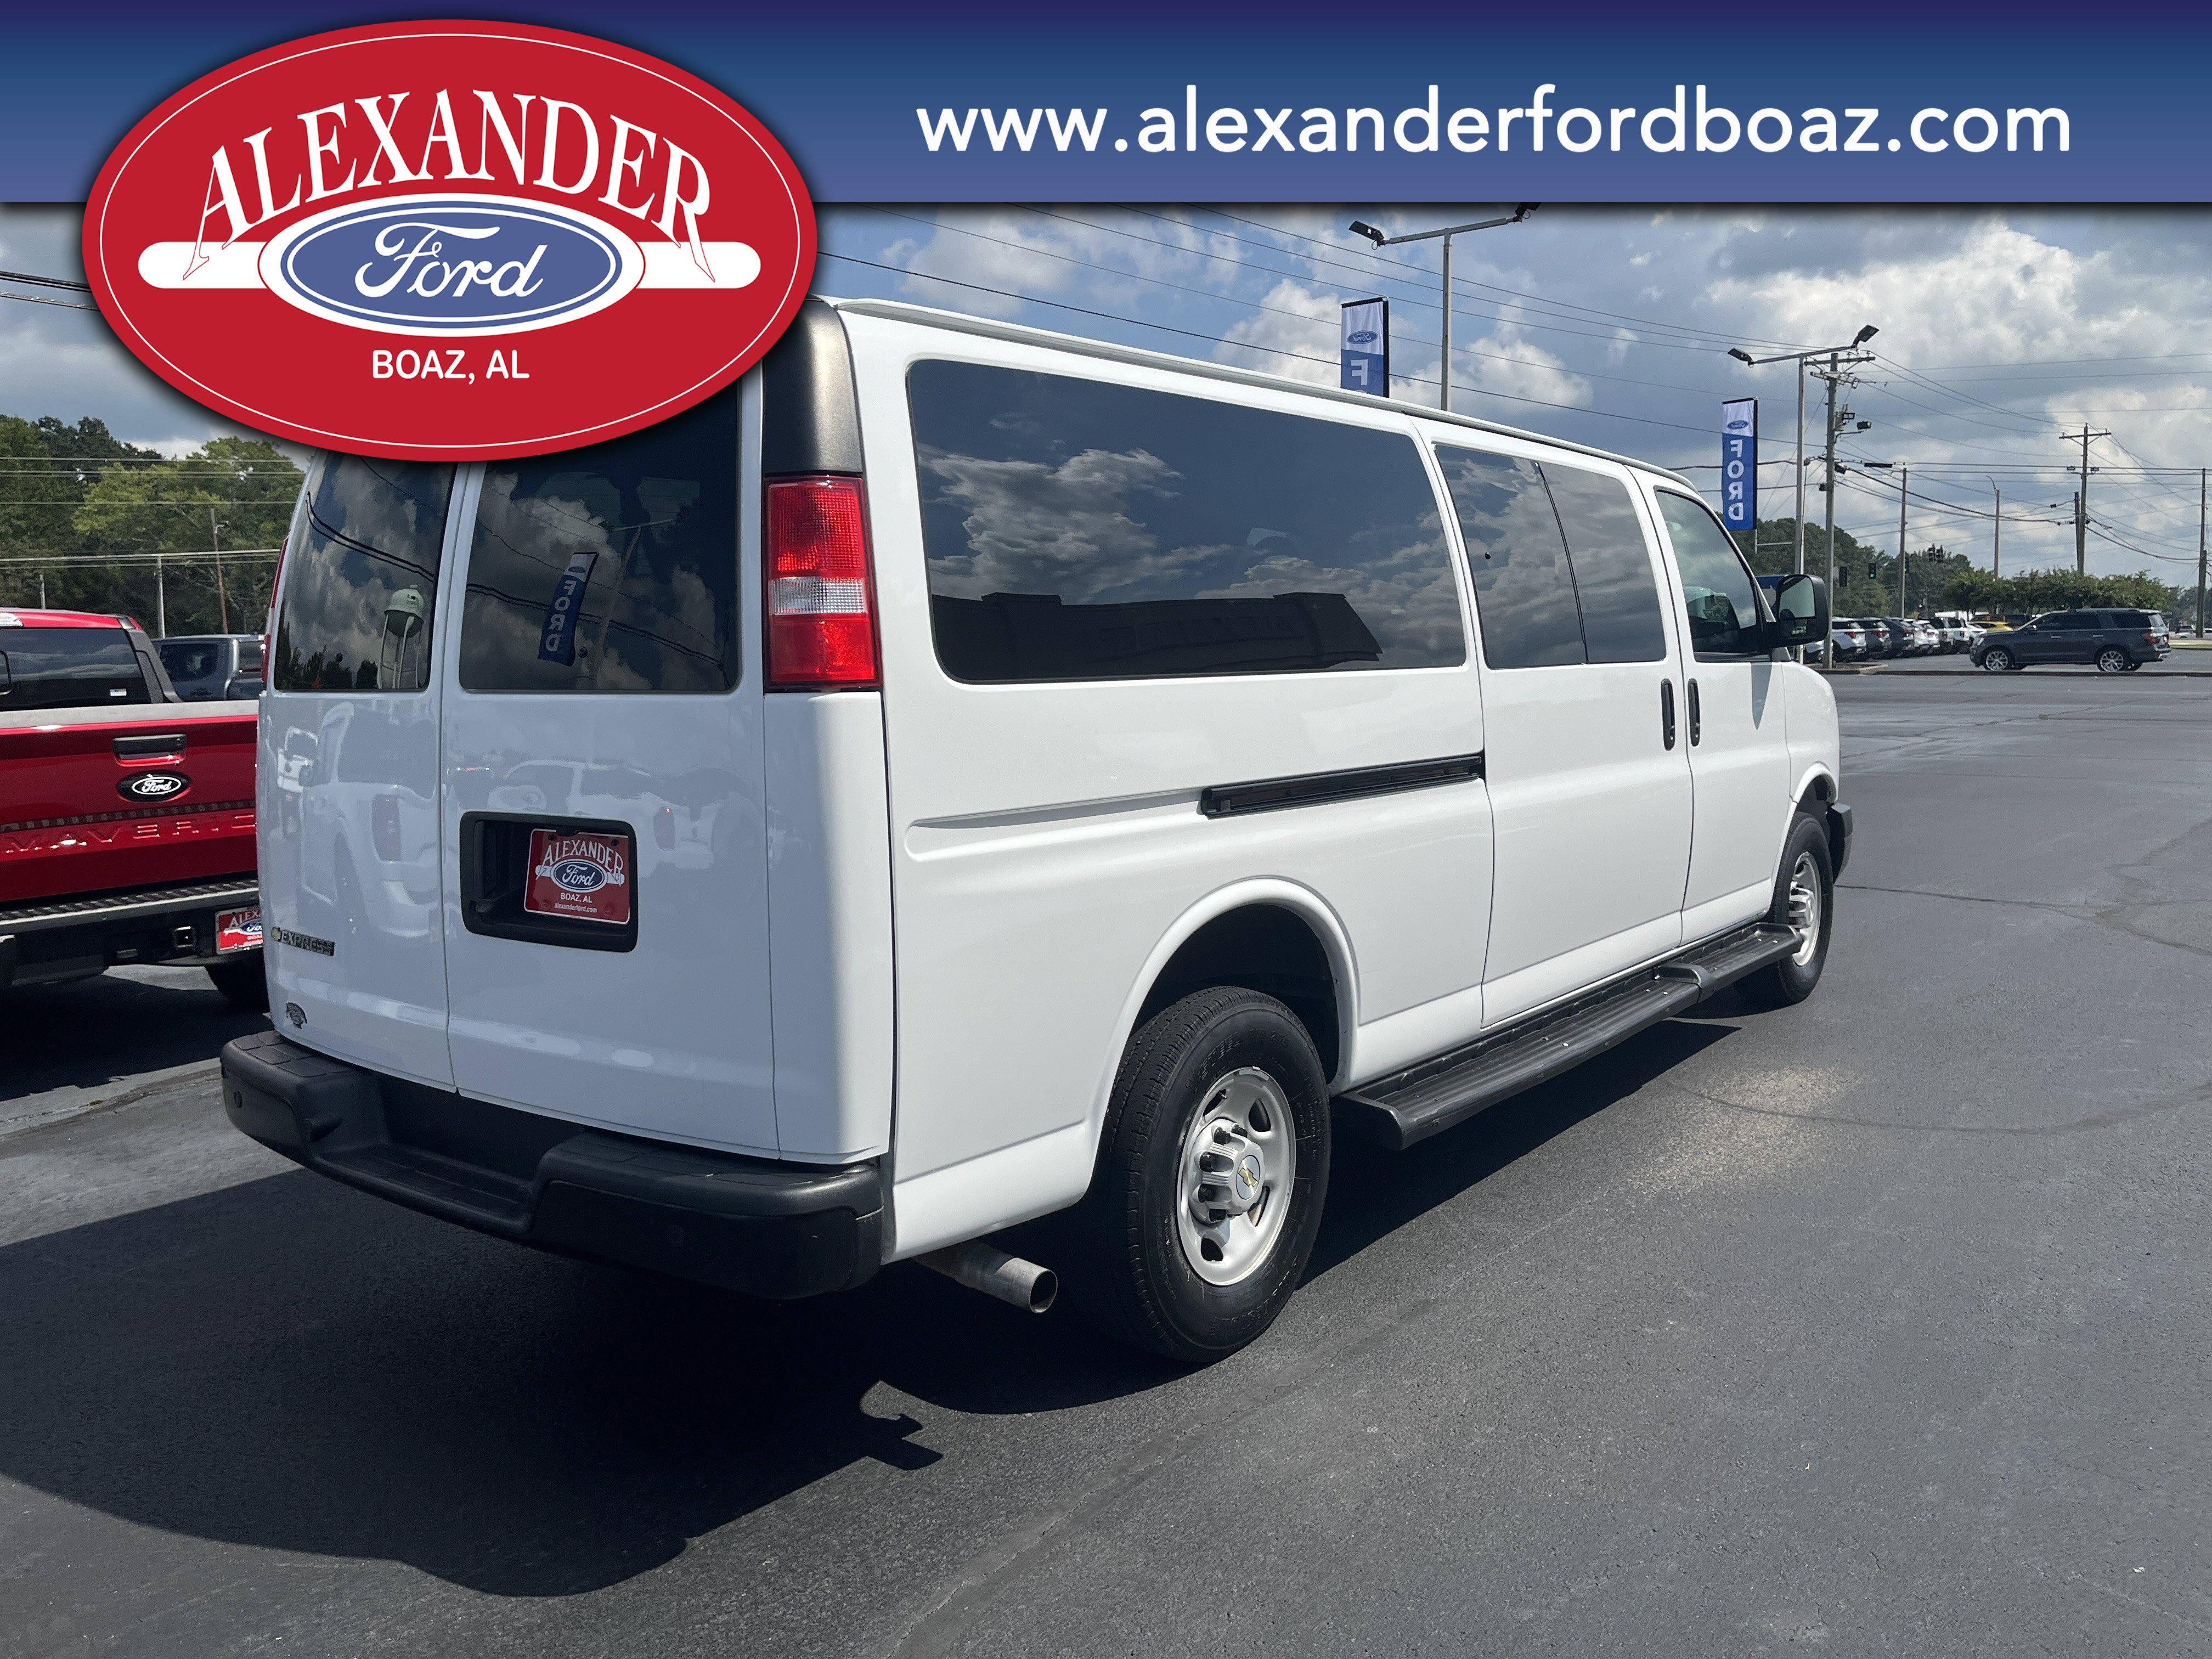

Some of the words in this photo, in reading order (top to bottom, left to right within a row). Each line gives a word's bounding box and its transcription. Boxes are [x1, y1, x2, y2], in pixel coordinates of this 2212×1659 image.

[141, 777, 172, 793] Ford
[535, 839, 624, 887] ALEXANDER
[562, 865, 595, 887] Ford
[554, 902, 597, 913] alexanderford.com
[560, 892, 582, 903] BOAZ,
[228, 910, 261, 930] ALEX
[281, 930, 333, 956] EXPRESS
